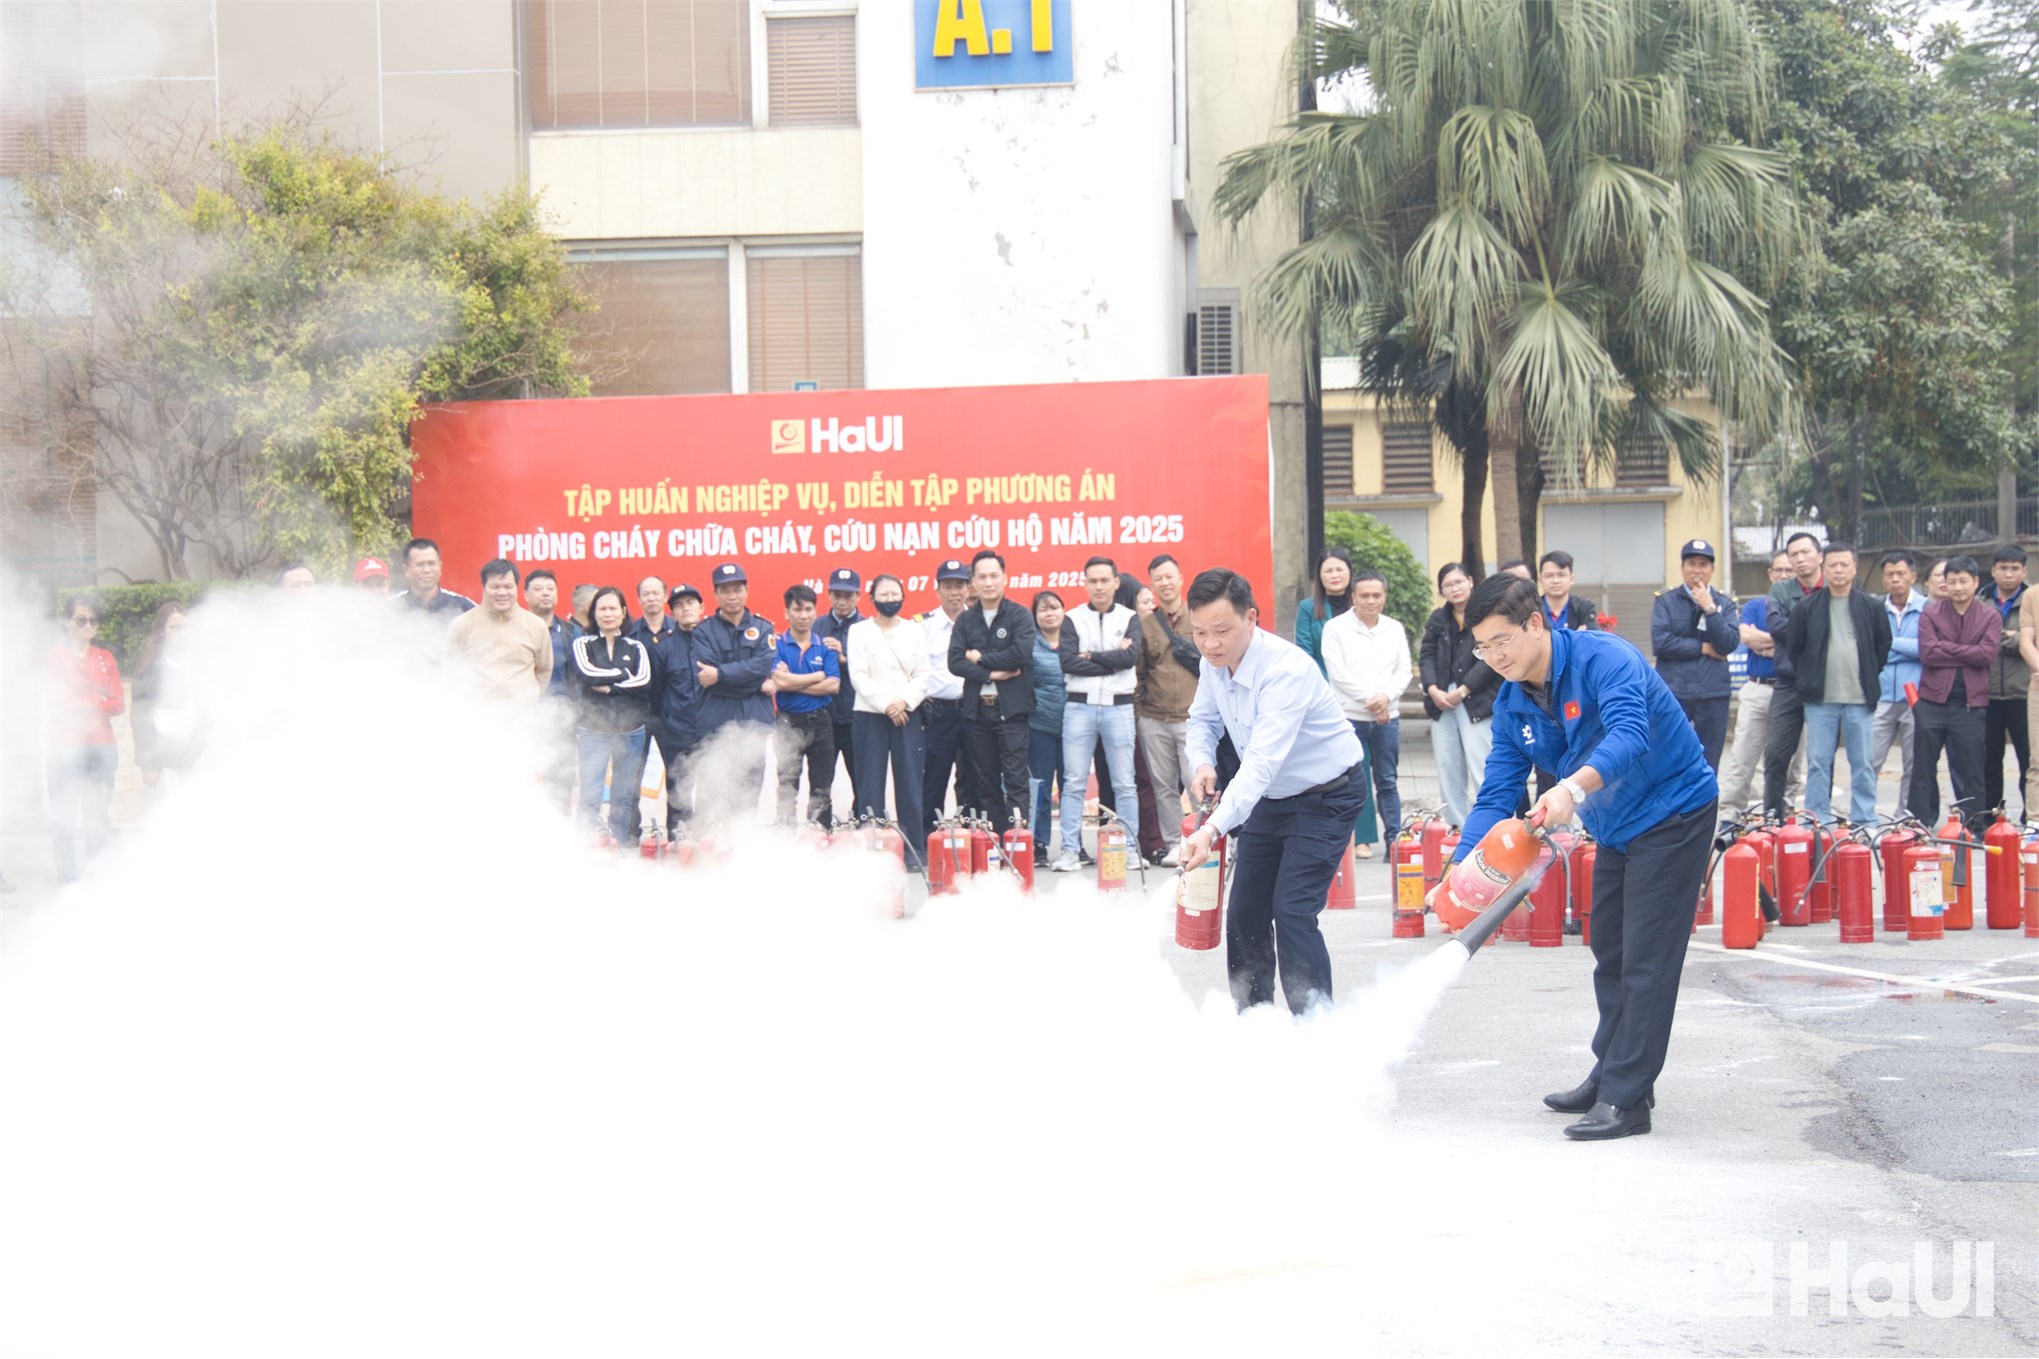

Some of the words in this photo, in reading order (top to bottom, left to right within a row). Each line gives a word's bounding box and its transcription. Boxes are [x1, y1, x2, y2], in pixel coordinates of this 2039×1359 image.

[811, 415, 903, 453] HaUI
[564, 484, 611, 522] TẬP
[619, 477, 688, 516] HUẤN
[696, 478, 789, 517] NGHIỆP
[796, 482, 836, 516] VỤ,
[844, 471, 903, 509] DIỄN
[911, 473, 959, 512] TẬP
[966, 473, 1071, 505] PHƯƠNG
[1079, 467, 1115, 501] ÁN
[498, 527, 586, 561] PHÒNG
[593, 524, 660, 560] CHÁY
[668, 523, 738, 558] CHỮA
[745, 520, 816, 557] CHÁY,
[824, 518, 876, 553] CỨU
[884, 521, 940, 556] NẠN
[948, 514, 1000, 549] CỨU
[1008, 513, 1043, 552] HỘ
[1051, 511, 1112, 546] NĂM
[1120, 514, 1184, 544] 2025
[907, 576, 929, 591] 07
[1009, 573, 1043, 588] năm
[1047, 571, 1086, 587] 2025
